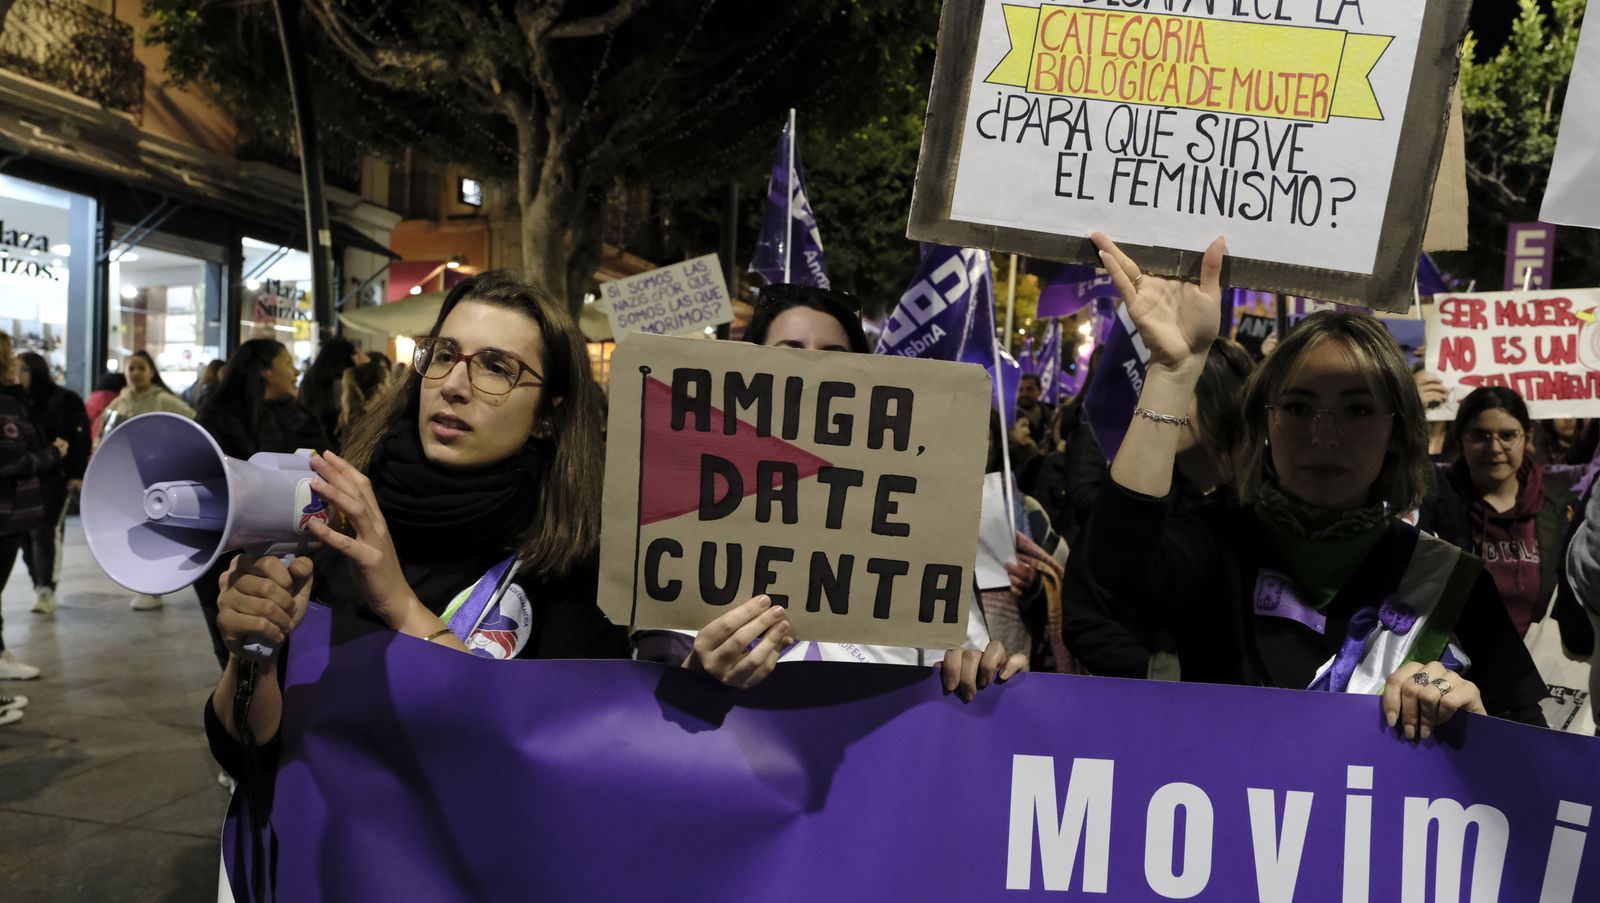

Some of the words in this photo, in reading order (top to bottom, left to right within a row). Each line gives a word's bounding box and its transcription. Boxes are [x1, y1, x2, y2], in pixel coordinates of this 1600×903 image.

[1040, 9, 1209, 65] CATEGORIA
[1034, 52, 1180, 104] BIOLÓGICA
[1185, 65, 1225, 107] DE
[1228, 67, 1331, 118] MUJER
[976, 91, 1092, 152] ¿PARA
[1105, 103, 1178, 159] QUÉ
[1187, 113, 1314, 174] SIRVE
[1054, 151, 1094, 201] EL
[1109, 158, 1357, 228] FEMINISMO?
[612, 293, 648, 312] NAZIS
[618, 304, 666, 328] SOMOS
[669, 295, 692, 312] LAS
[695, 285, 722, 303] QUE
[627, 270, 673, 294] SOMOS
[683, 260, 708, 277] LAS
[1439, 297, 1488, 330] SER
[1494, 297, 1578, 327] MUJER
[1437, 336, 1476, 372] NO
[1491, 336, 1527, 365] ES
[1535, 334, 1577, 365] UN
[671, 368, 925, 456] AMIGA,
[699, 453, 917, 537] DATE
[644, 537, 963, 624] CUENTA
[1005, 753, 1592, 903] Movimi
